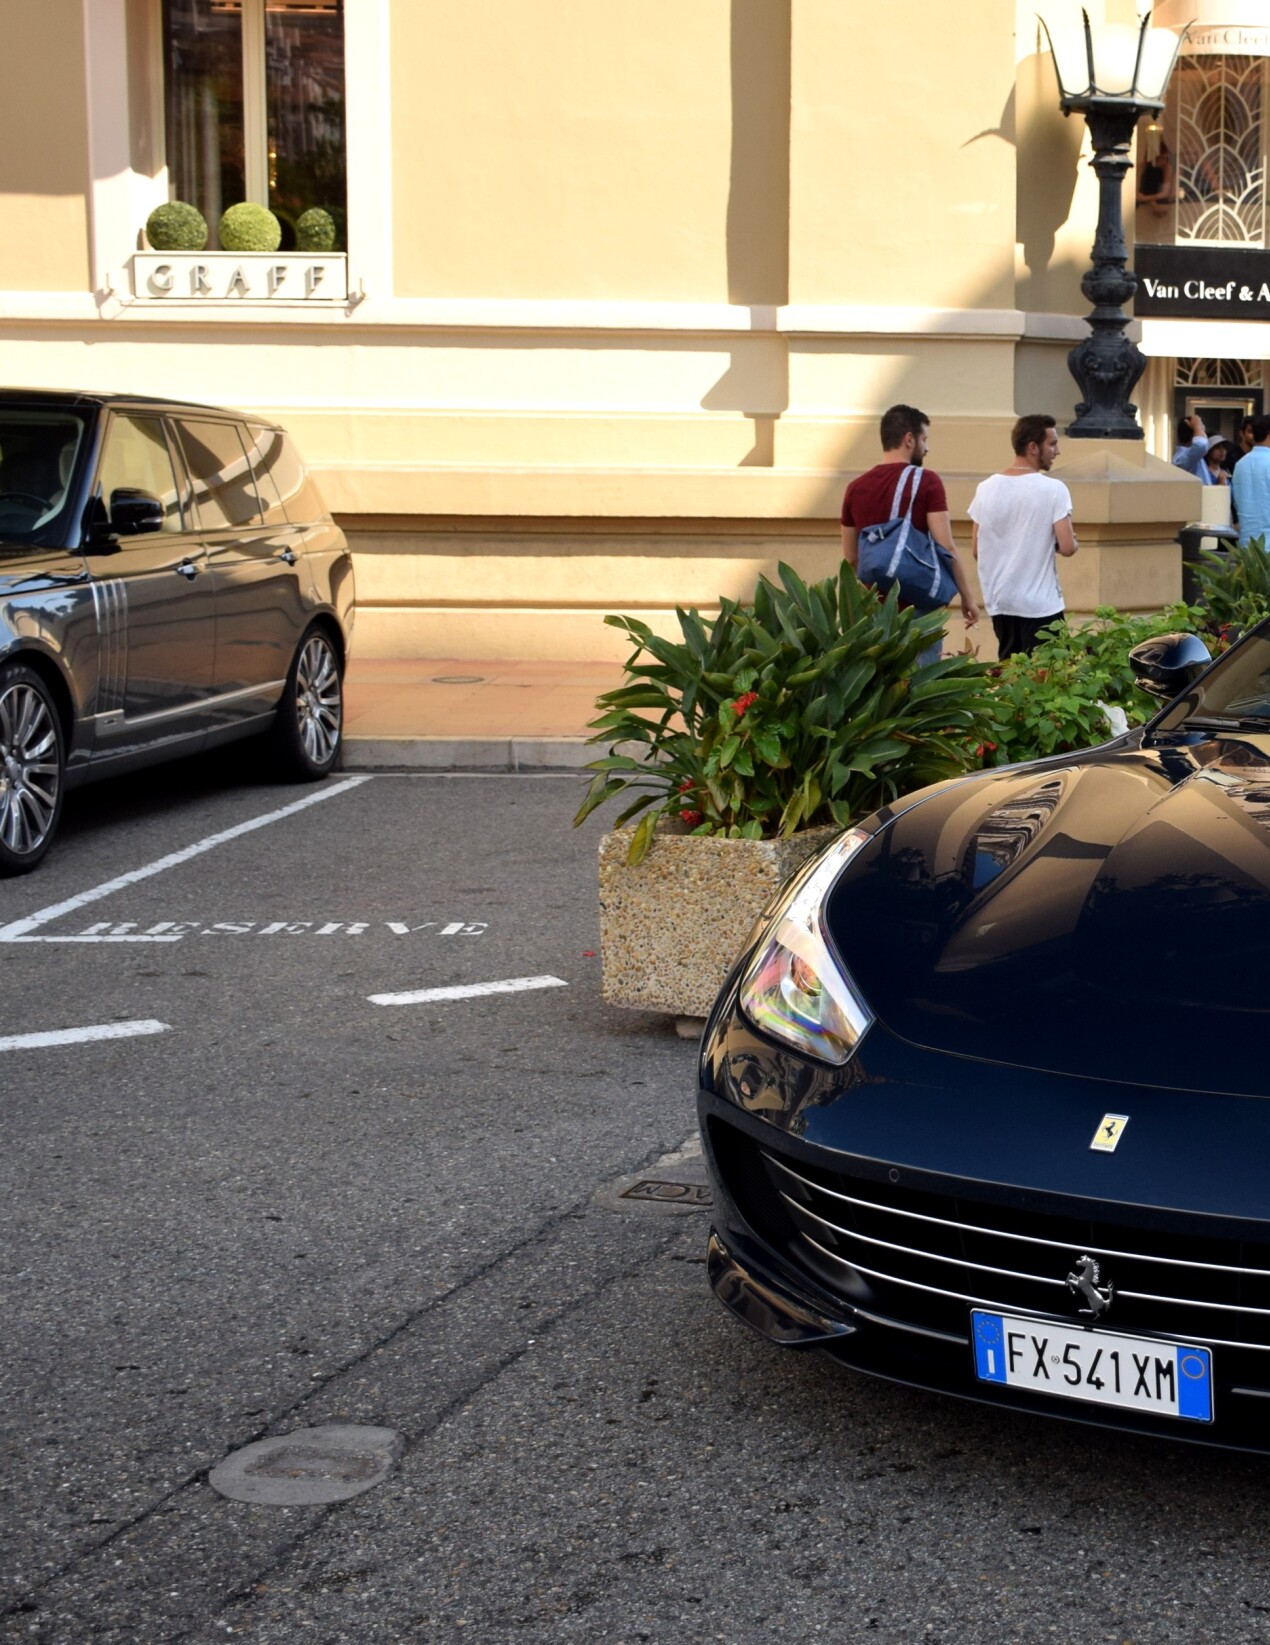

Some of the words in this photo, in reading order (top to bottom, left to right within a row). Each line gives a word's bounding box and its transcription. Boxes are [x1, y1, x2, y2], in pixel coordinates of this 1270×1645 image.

[150, 264, 325, 293] GRAFF
[1143, 278, 1179, 299] Van
[1184, 280, 1236, 300] Cleef
[1239, 286, 1254, 301] &
[78, 921, 489, 936] RESERVE
